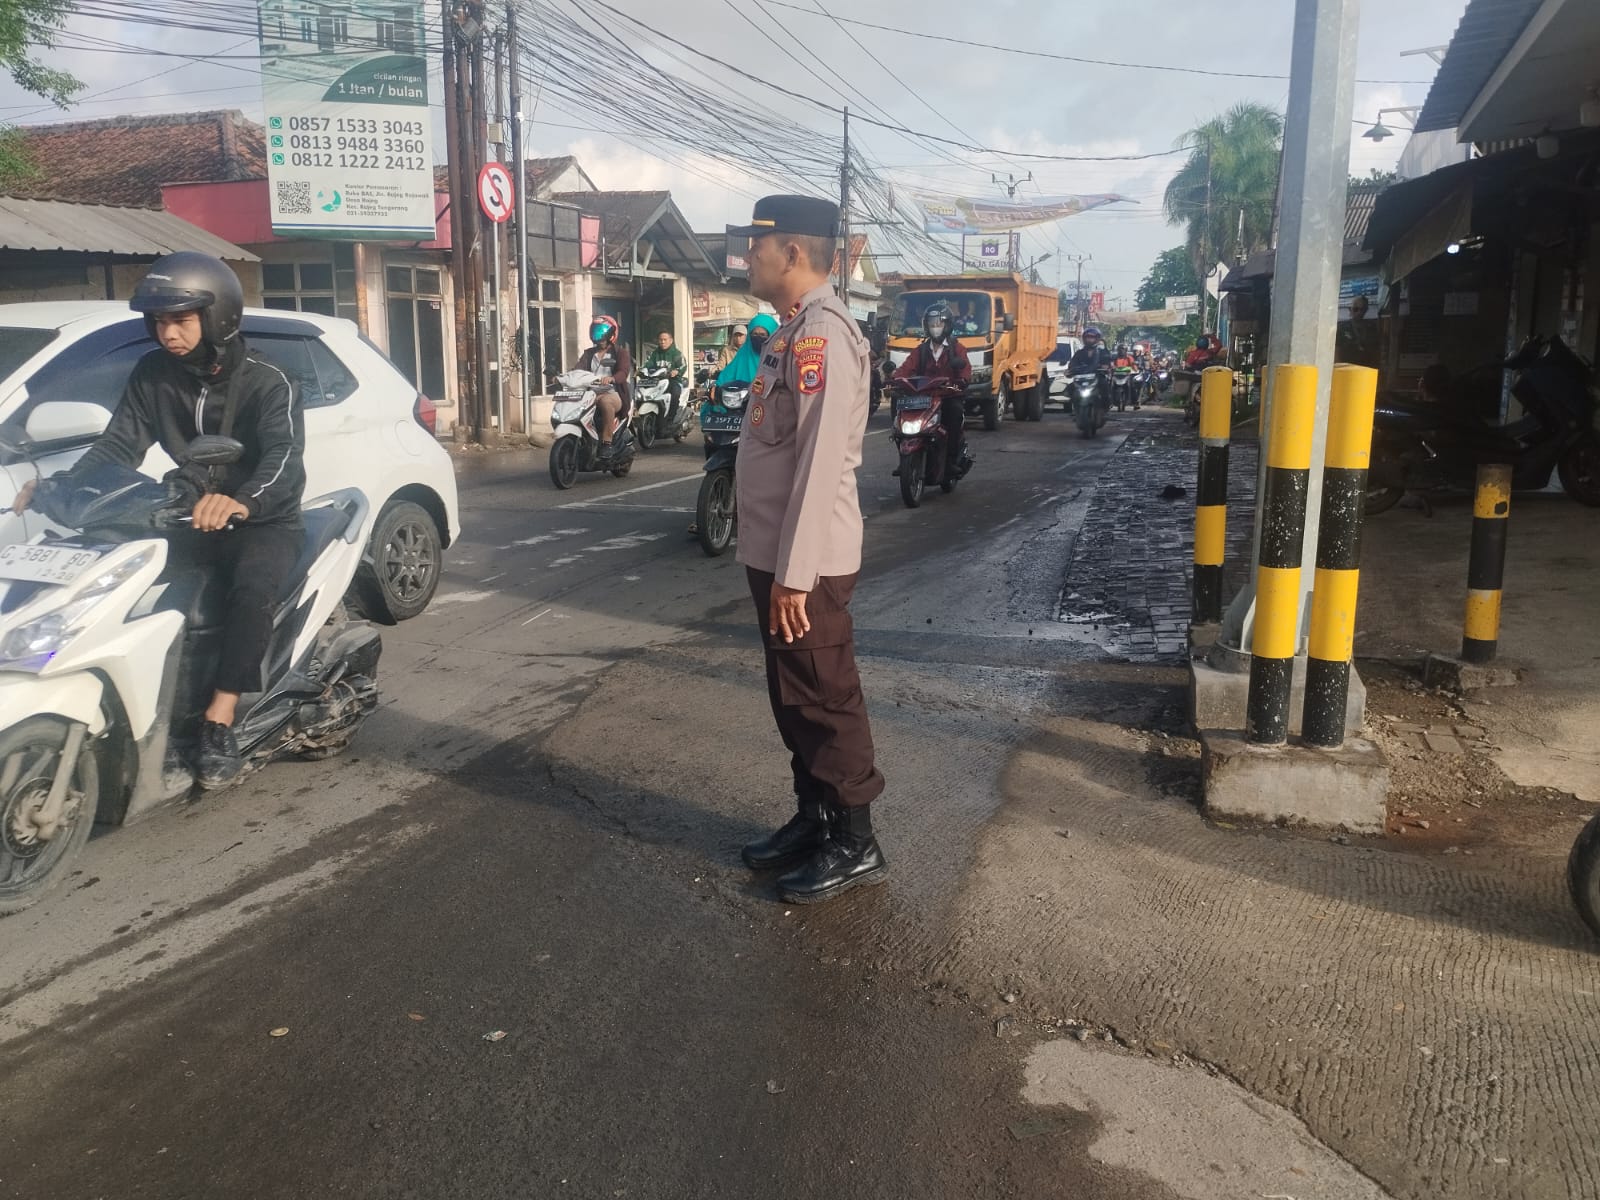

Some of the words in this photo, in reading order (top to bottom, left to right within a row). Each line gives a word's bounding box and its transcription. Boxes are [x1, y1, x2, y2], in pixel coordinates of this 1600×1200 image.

[373, 73, 397, 81] cicilan
[398, 74, 422, 83] ringan
[388, 84, 423, 98] bulan
[289, 116, 331, 132] 0857
[336, 118, 378, 133] 1533
[382, 120, 424, 136] 3043
[290, 134, 332, 150] 0813
[337, 136, 379, 151] 9484
[383, 138, 425, 154] 3360
[291, 152, 333, 167] 0812
[339, 154, 380, 169] 1222
[384, 155, 426, 171] 2412
[489, 173, 504, 208] S
